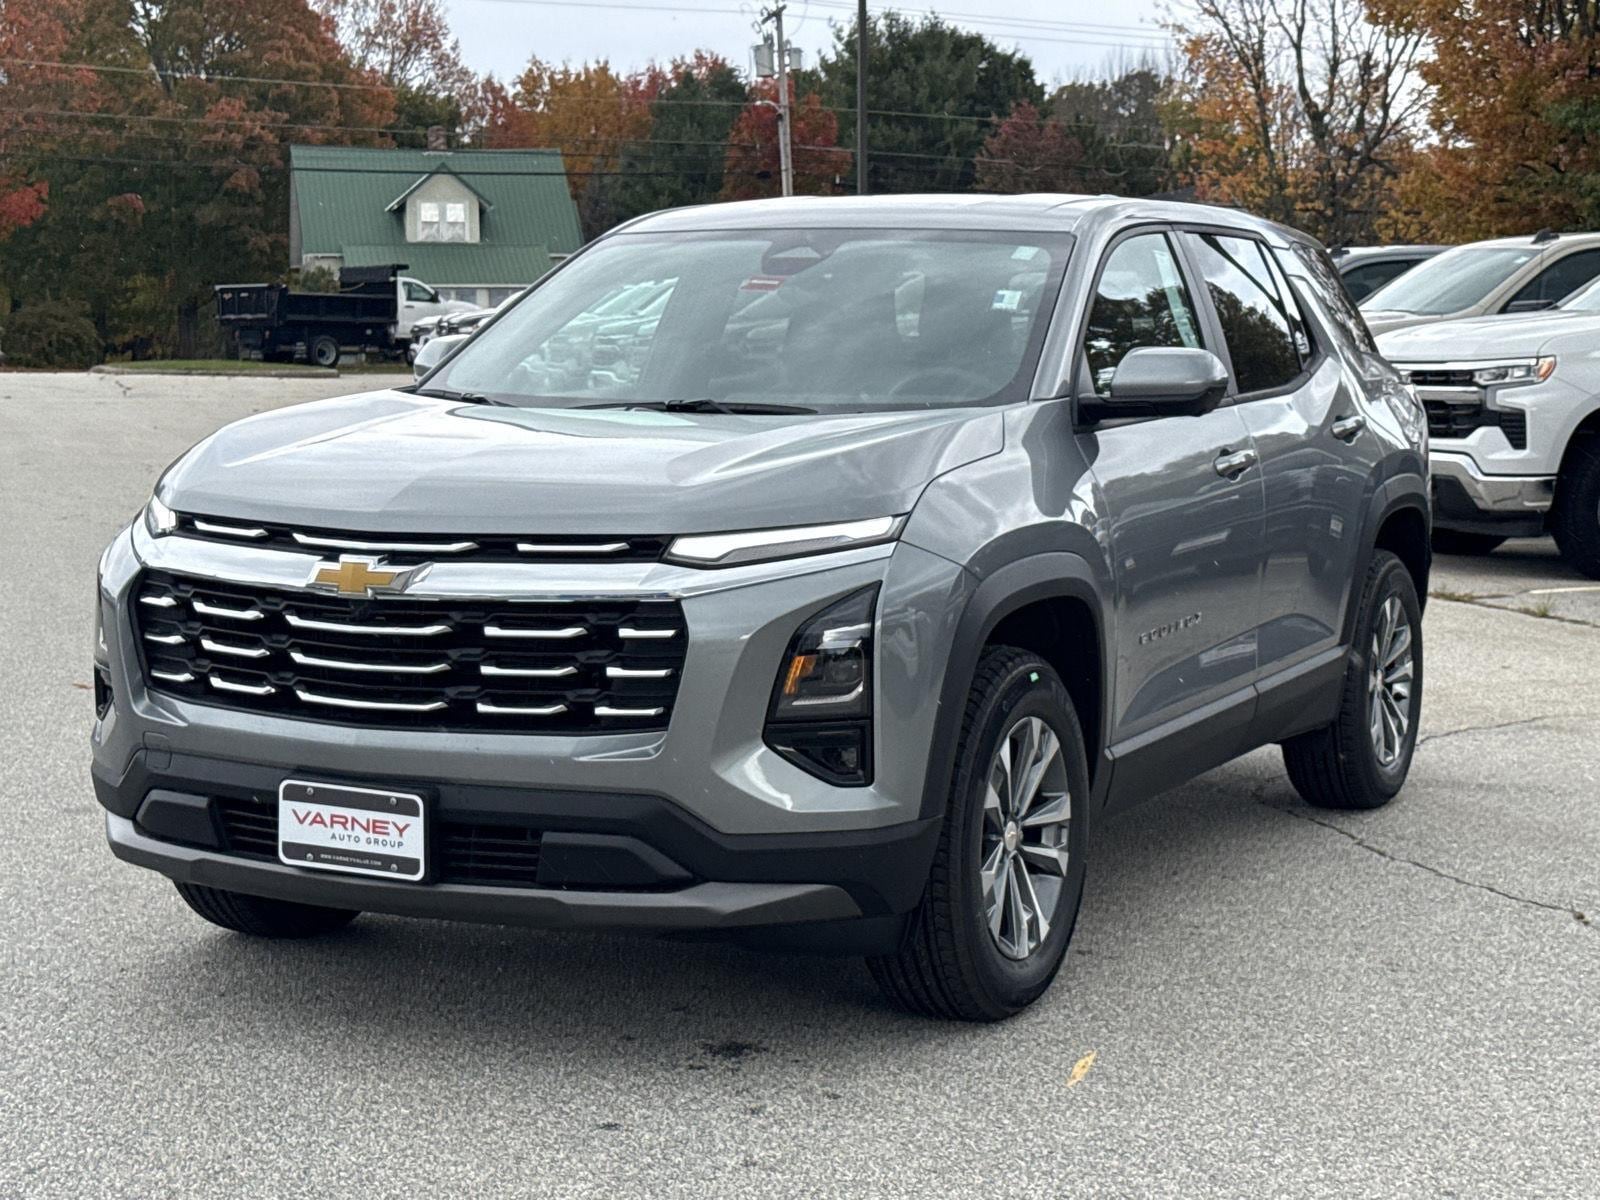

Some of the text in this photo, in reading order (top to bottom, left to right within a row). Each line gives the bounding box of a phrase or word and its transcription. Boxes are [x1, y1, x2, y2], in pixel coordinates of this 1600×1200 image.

[292, 809, 411, 837] VARNEY
[330, 832, 404, 848] AUTO GROUP
